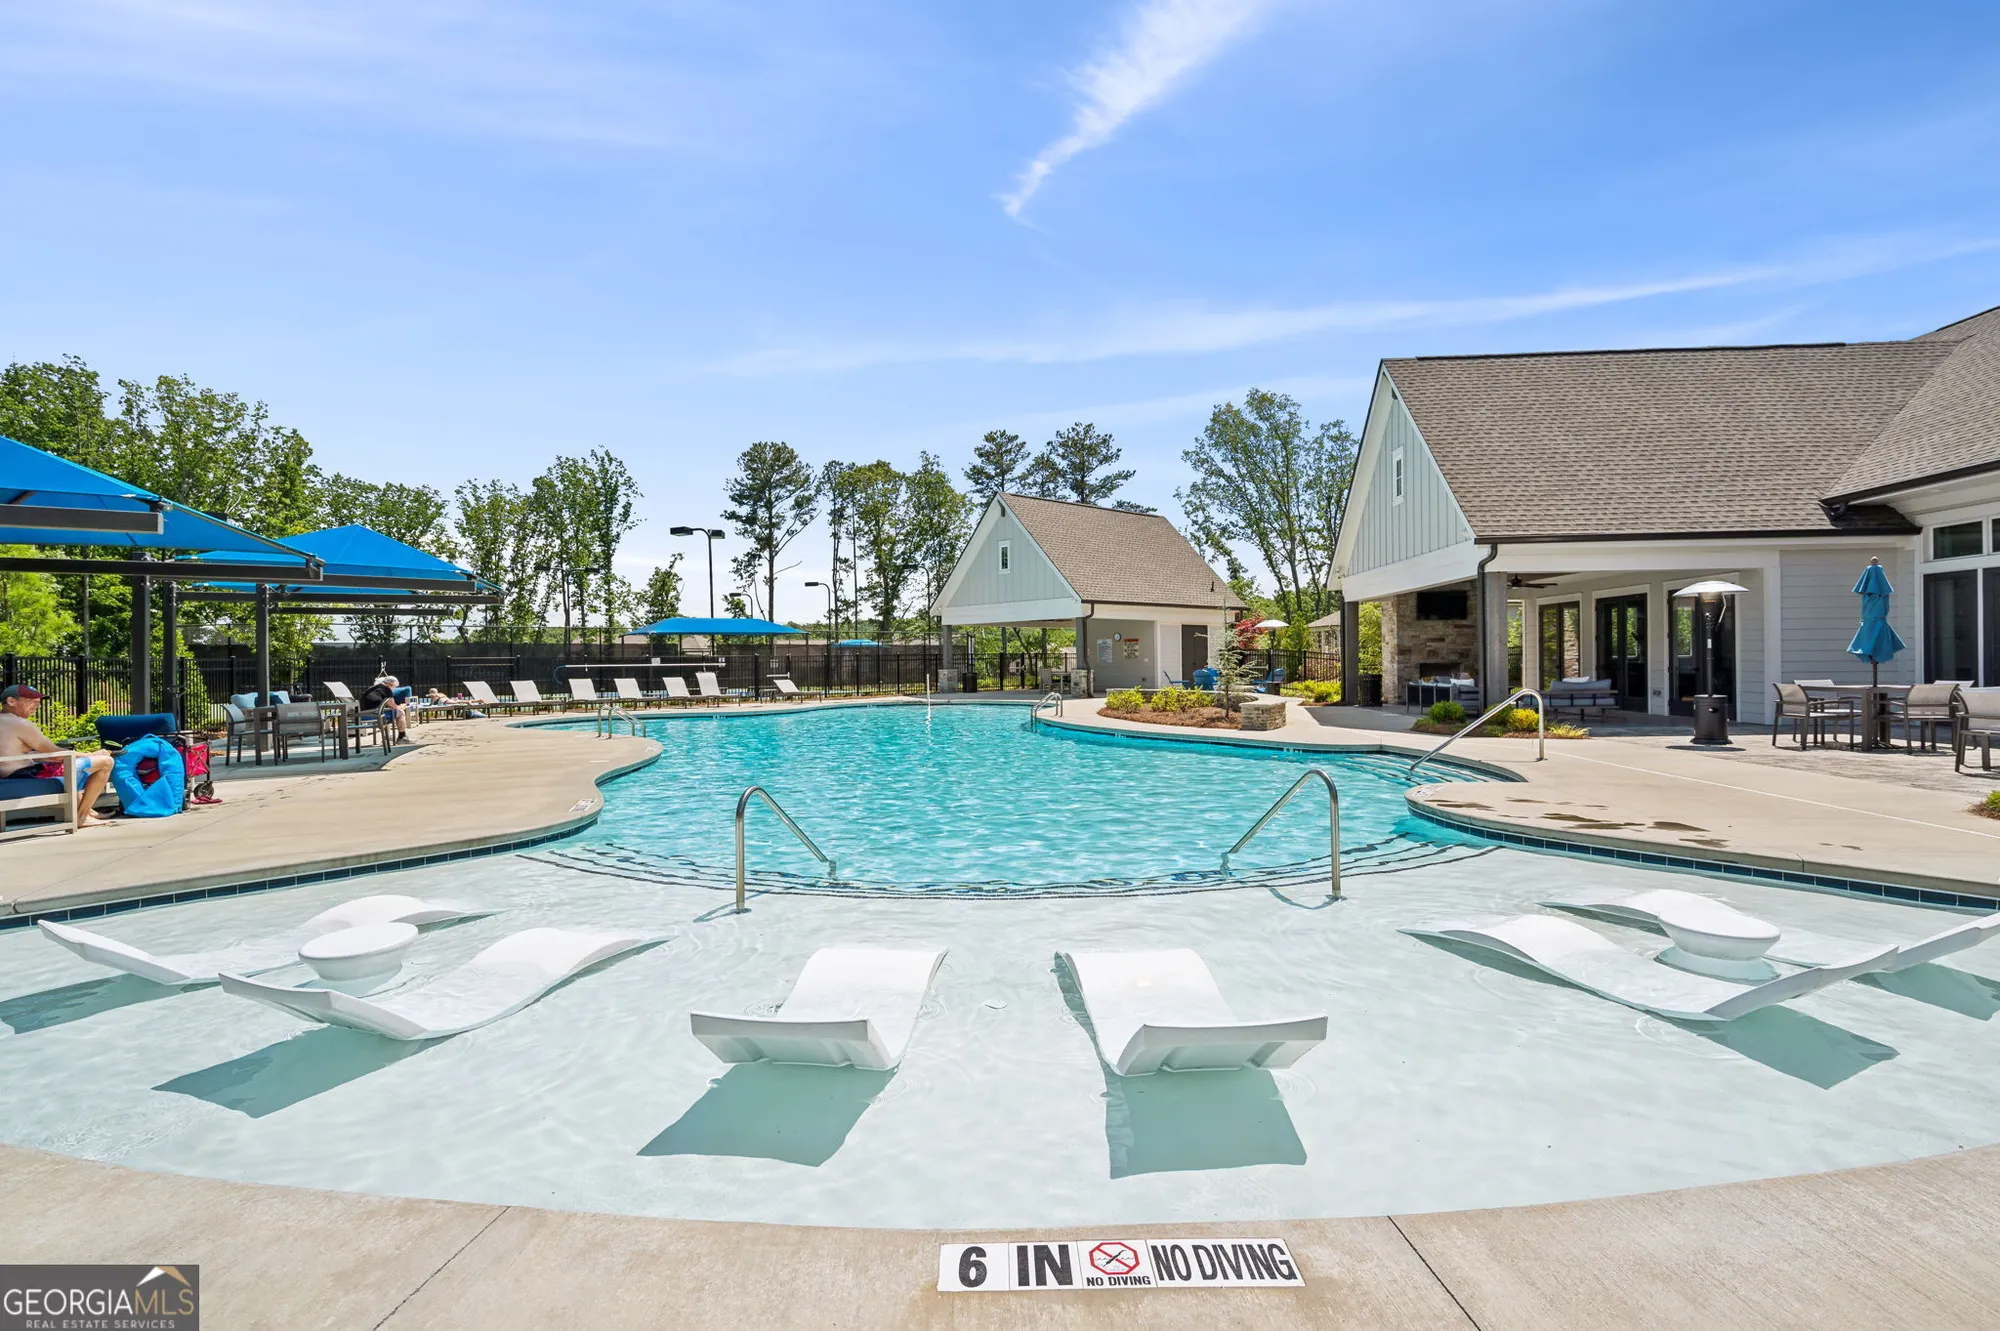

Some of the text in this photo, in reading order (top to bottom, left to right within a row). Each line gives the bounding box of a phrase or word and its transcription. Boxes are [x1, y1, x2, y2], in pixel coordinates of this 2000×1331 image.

[958, 1244, 1074, 1288] 6 IN
[1086, 1275, 1151, 1287] NO DIVING
[1150, 1243, 1298, 1282] NO DIVING
